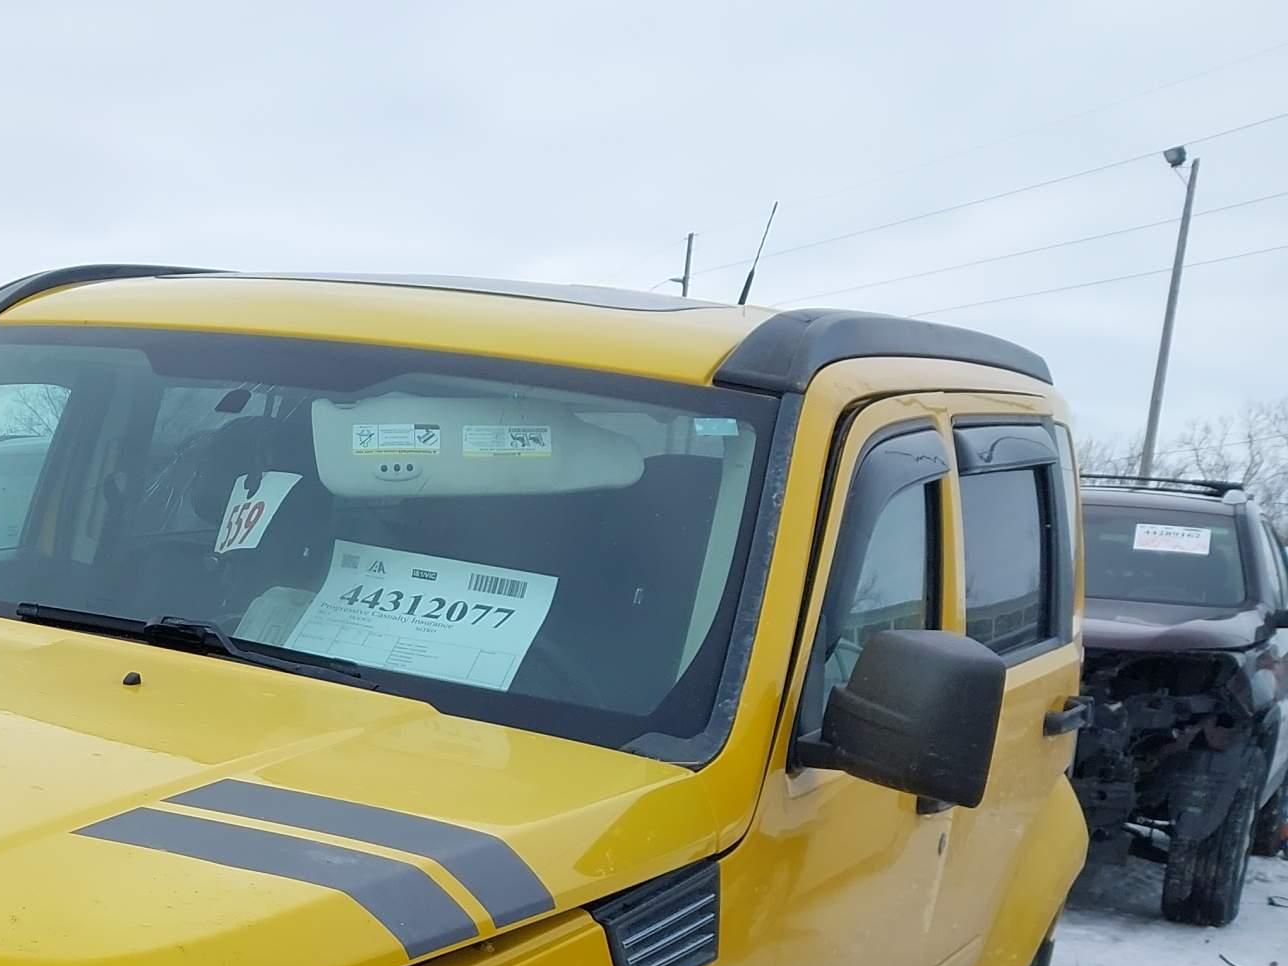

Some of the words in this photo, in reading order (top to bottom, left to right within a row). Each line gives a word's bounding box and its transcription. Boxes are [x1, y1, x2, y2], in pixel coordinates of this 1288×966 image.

[219, 500, 266, 551] 559
[320, 601, 371, 617] Progressive
[371, 611, 409, 624] Casualty
[411, 617, 454, 629] Insurance
[340, 584, 516, 629] 44312077
